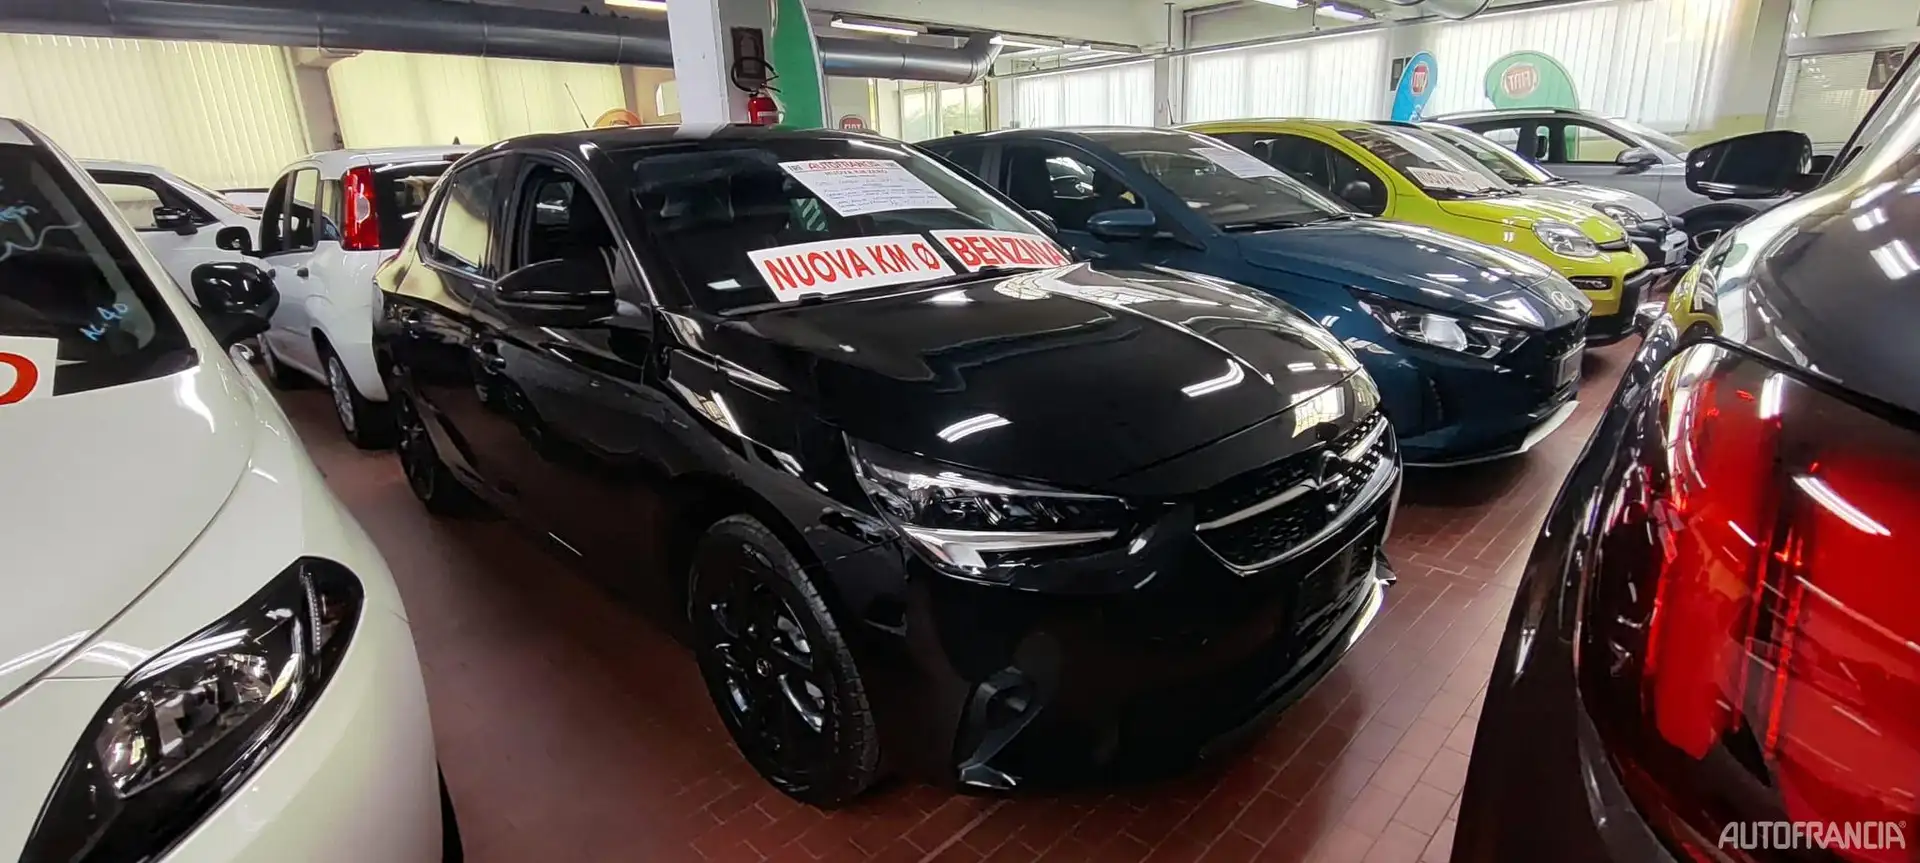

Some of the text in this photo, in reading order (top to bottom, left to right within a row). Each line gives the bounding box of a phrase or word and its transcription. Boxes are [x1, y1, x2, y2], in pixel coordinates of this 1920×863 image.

[764, 248, 876, 291] NUOVA
[866, 244, 920, 275] KM
[944, 236, 1062, 267] BENZINA
